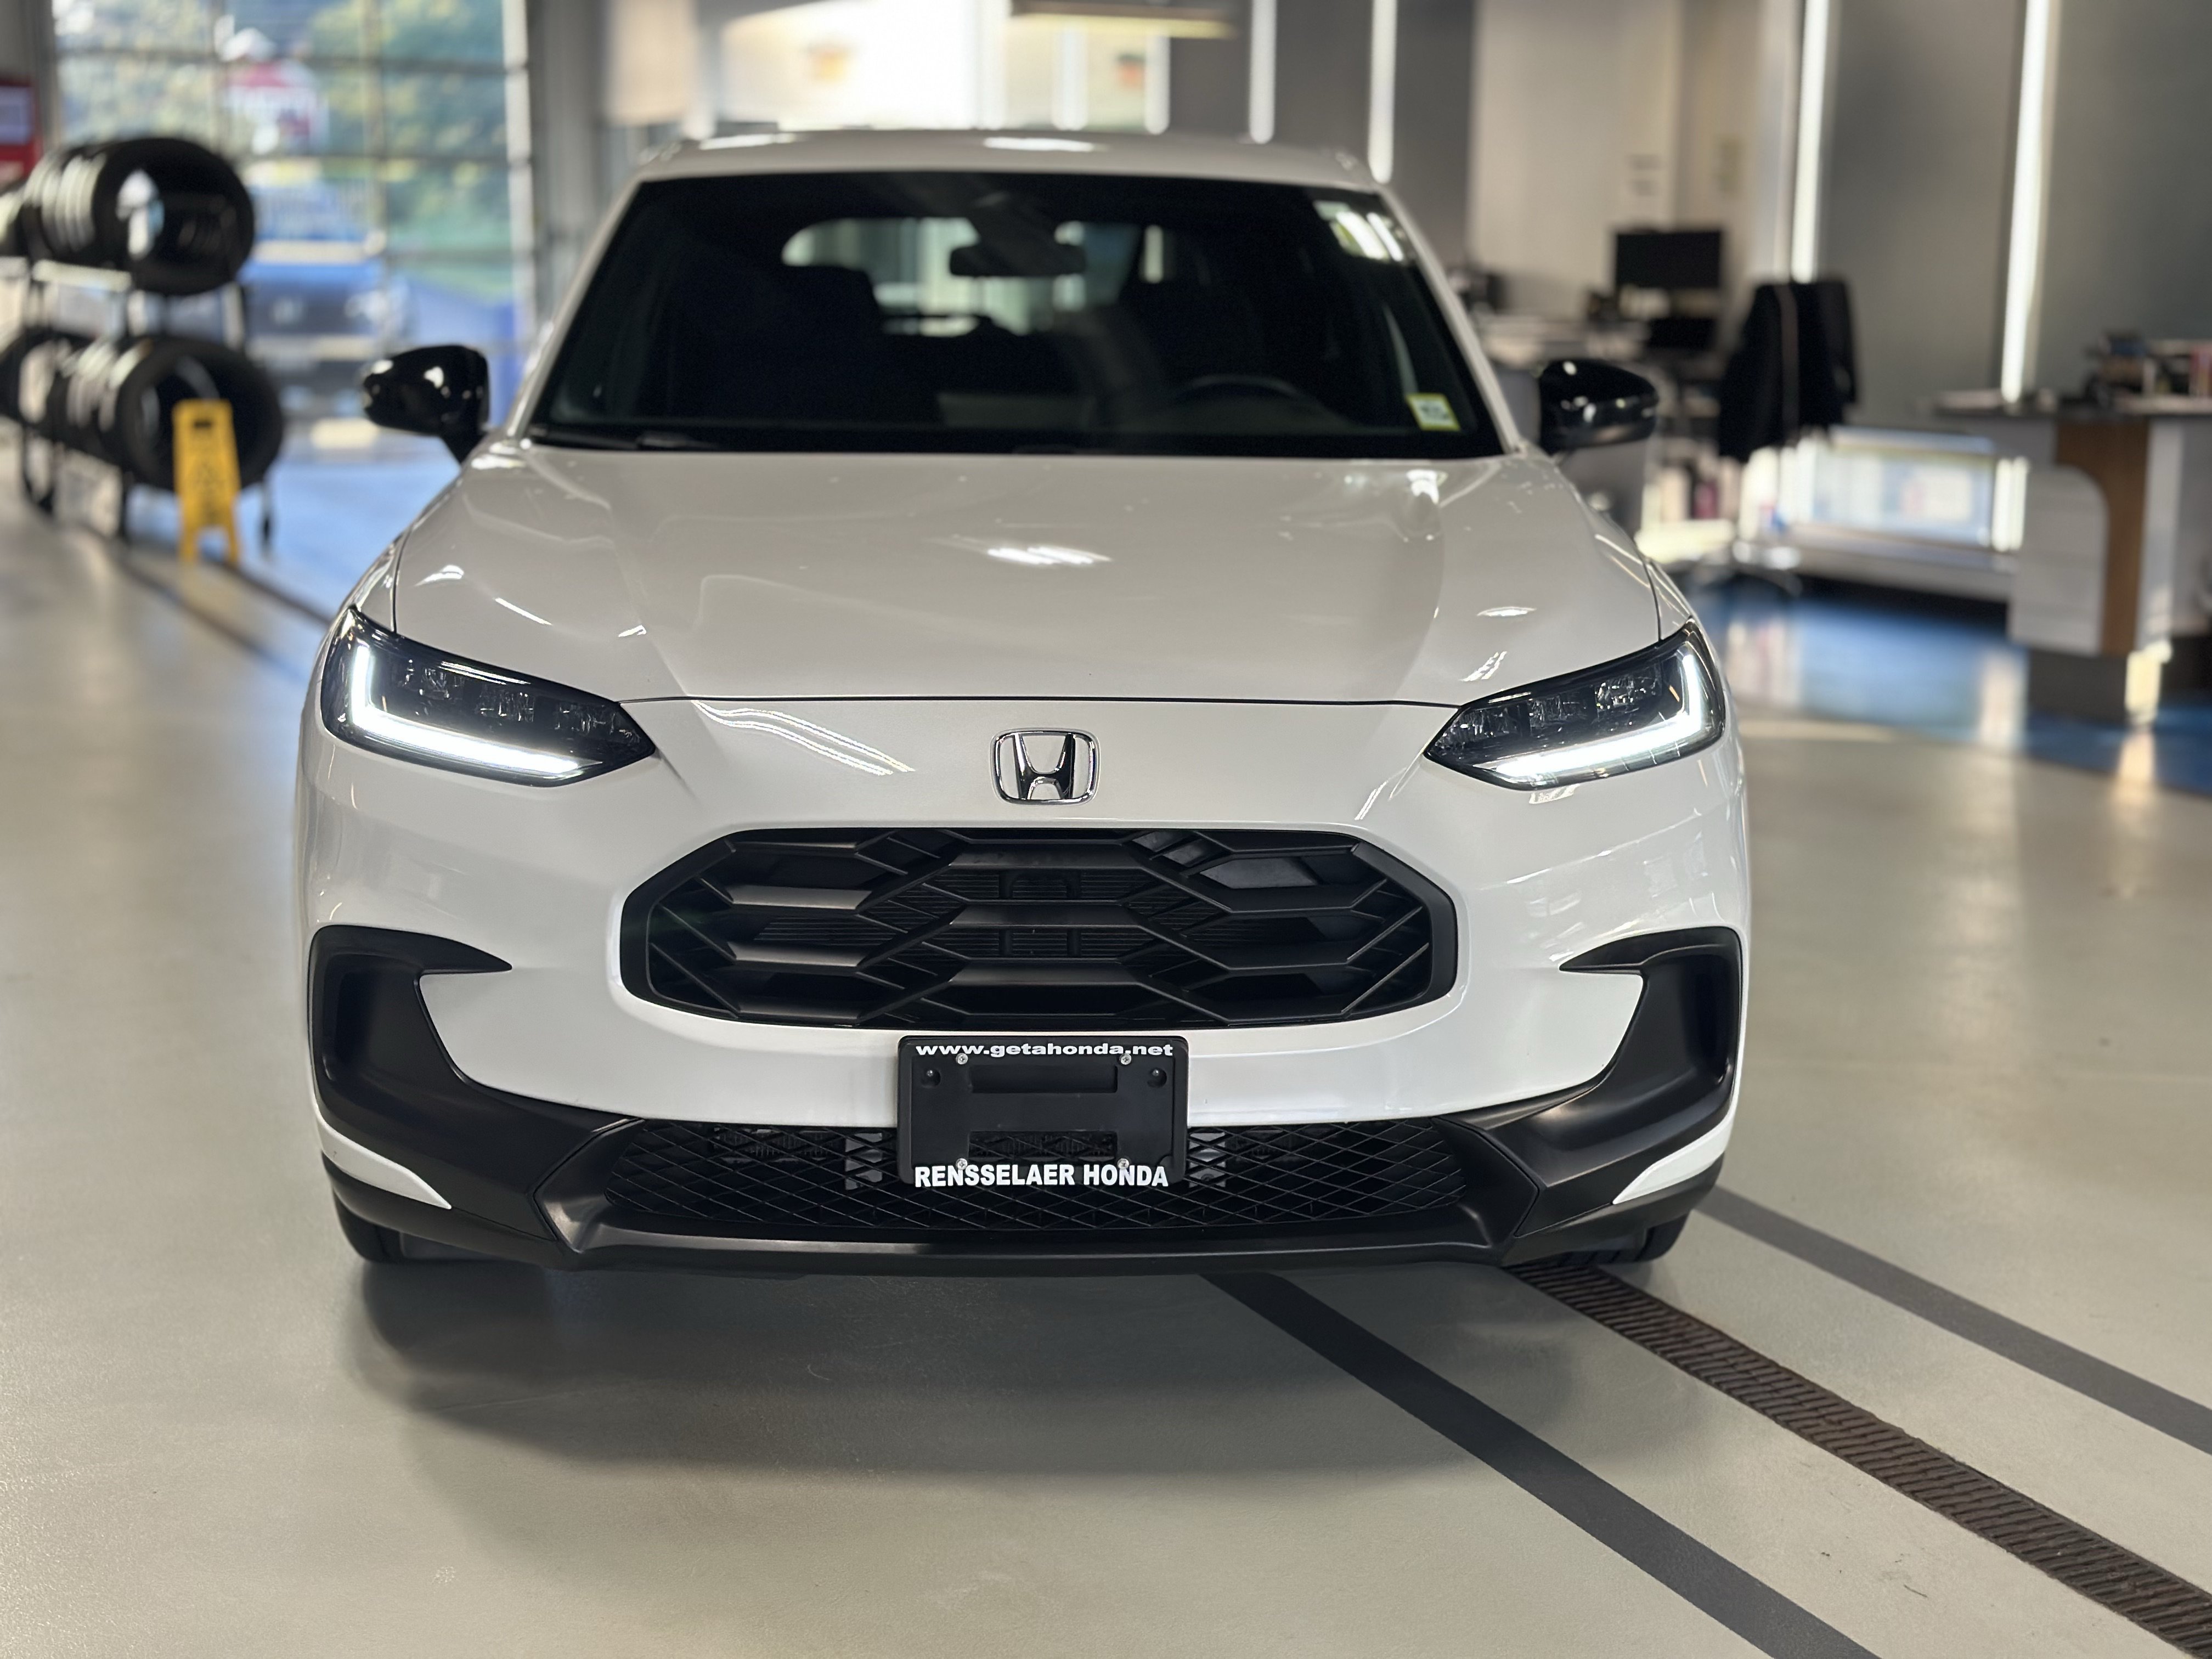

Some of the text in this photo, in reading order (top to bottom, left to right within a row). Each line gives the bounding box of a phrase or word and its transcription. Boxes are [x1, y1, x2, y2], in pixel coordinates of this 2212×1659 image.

[916, 1043, 1173, 1057] www.getahonda.net
[915, 1164, 1168, 1187] RENSSELAER HONDA
